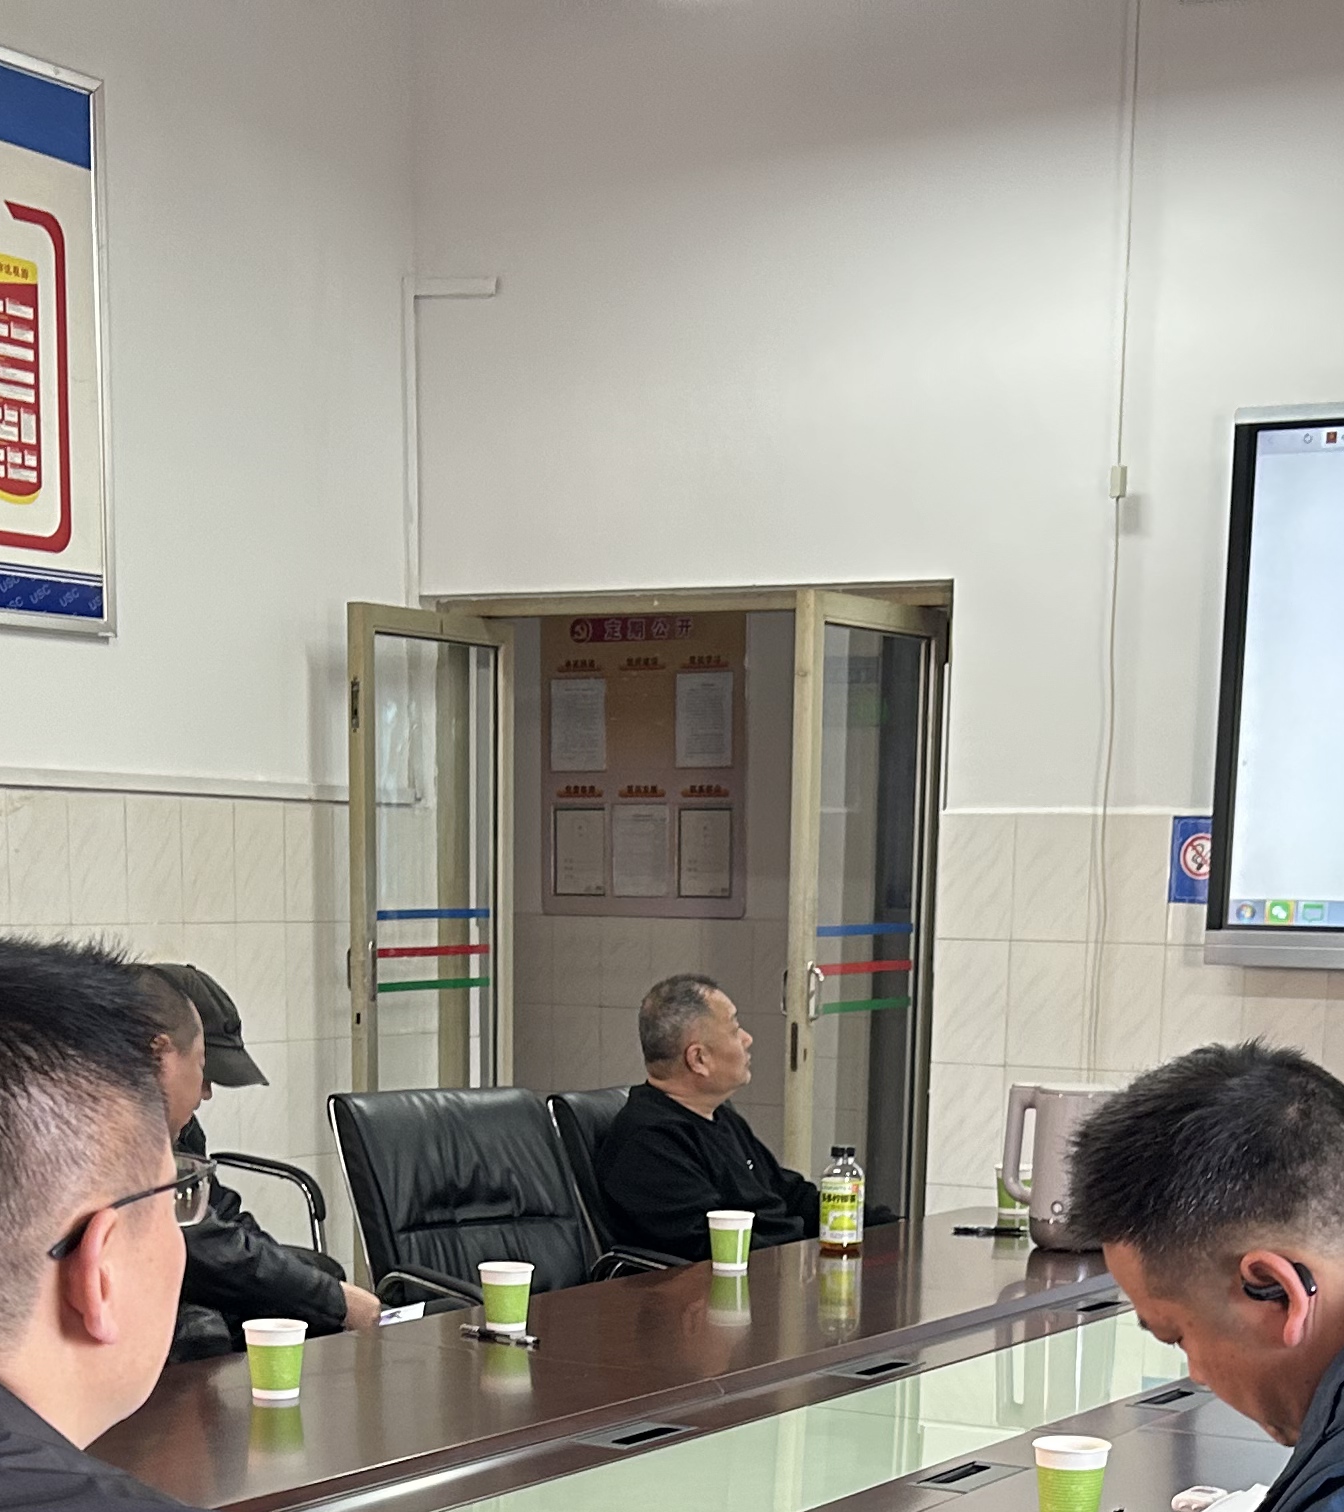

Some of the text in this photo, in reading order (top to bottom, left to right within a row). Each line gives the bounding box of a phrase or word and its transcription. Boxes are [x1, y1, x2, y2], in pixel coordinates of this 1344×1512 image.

[0, 575, 22, 593] USC
[29, 584, 51, 603] USC
[59, 588, 80, 607] USC
[604, 617, 692, 640] 定期公开
